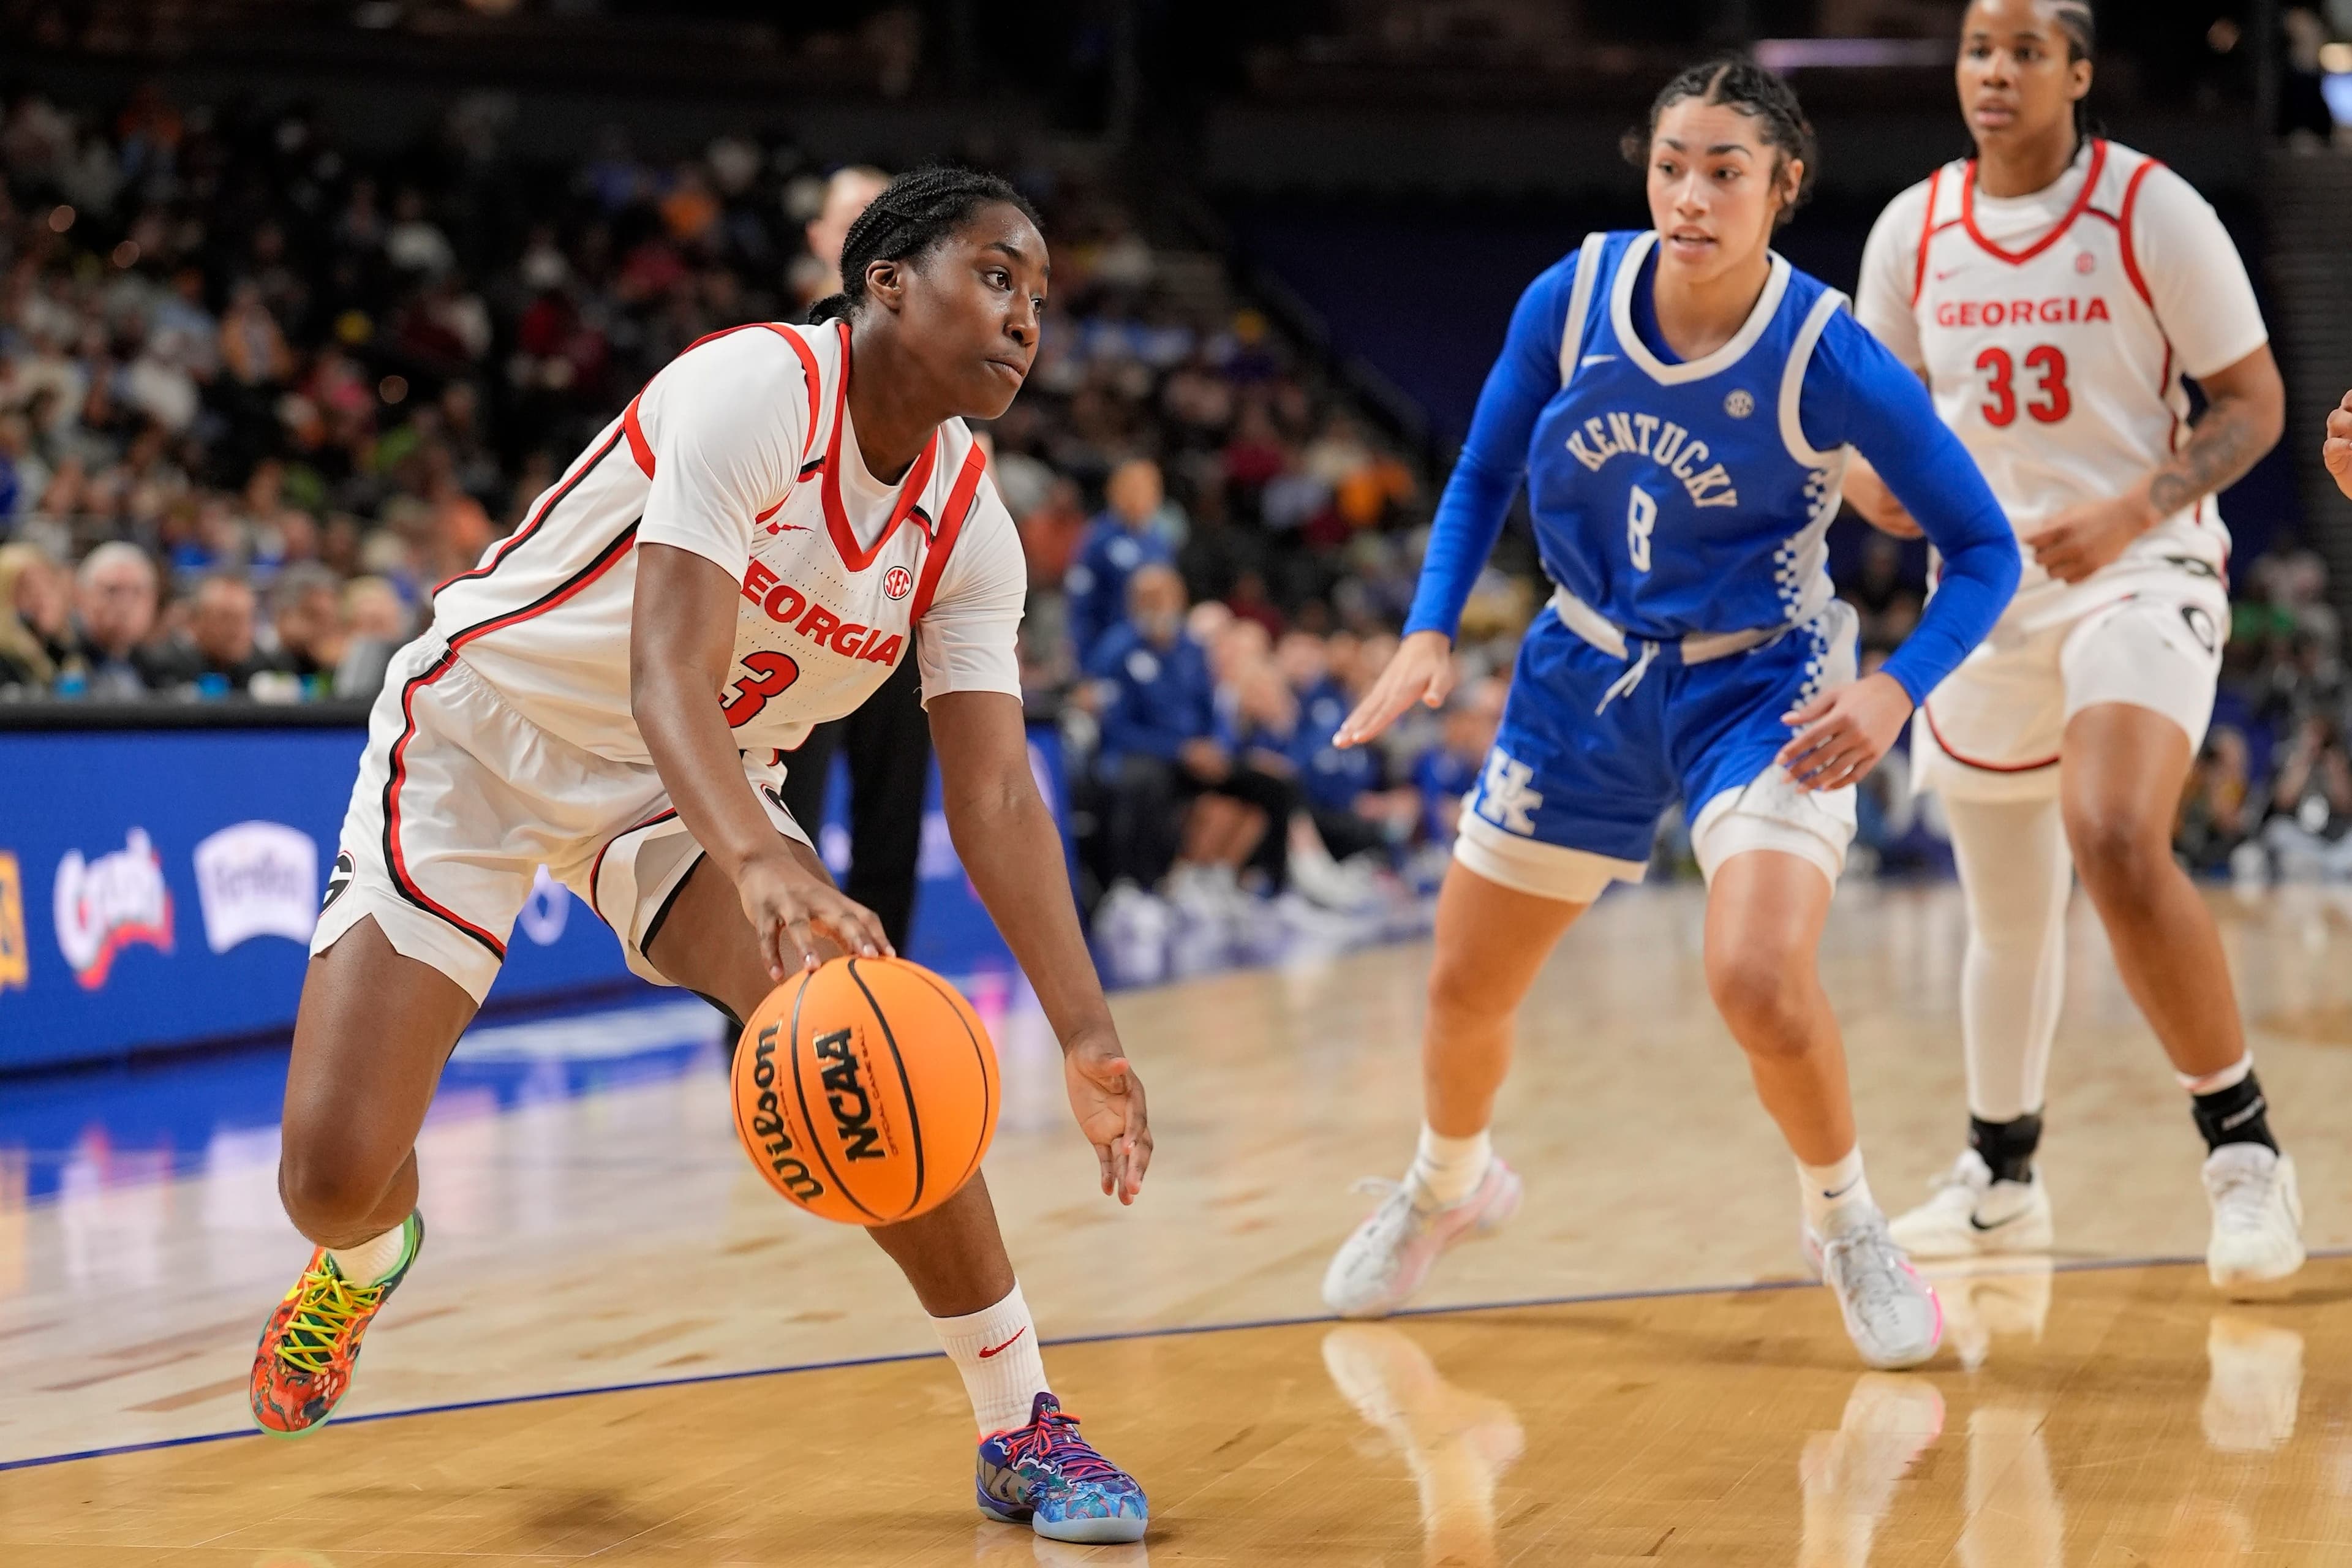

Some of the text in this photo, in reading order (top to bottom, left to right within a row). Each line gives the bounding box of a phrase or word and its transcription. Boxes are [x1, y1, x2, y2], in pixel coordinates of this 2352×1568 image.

[1936, 296, 2111, 327] GEORGIA
[1975, 344, 2071, 428] 33
[1566, 412, 1738, 508] KENTUCKY
[1627, 484, 1657, 572] 8
[740, 556, 903, 666] EORGIA
[886, 570, 910, 597] SEC
[718, 650, 799, 728] 3
[753, 1019, 825, 1203] Wilson
[813, 1027, 887, 1164] NCAA
